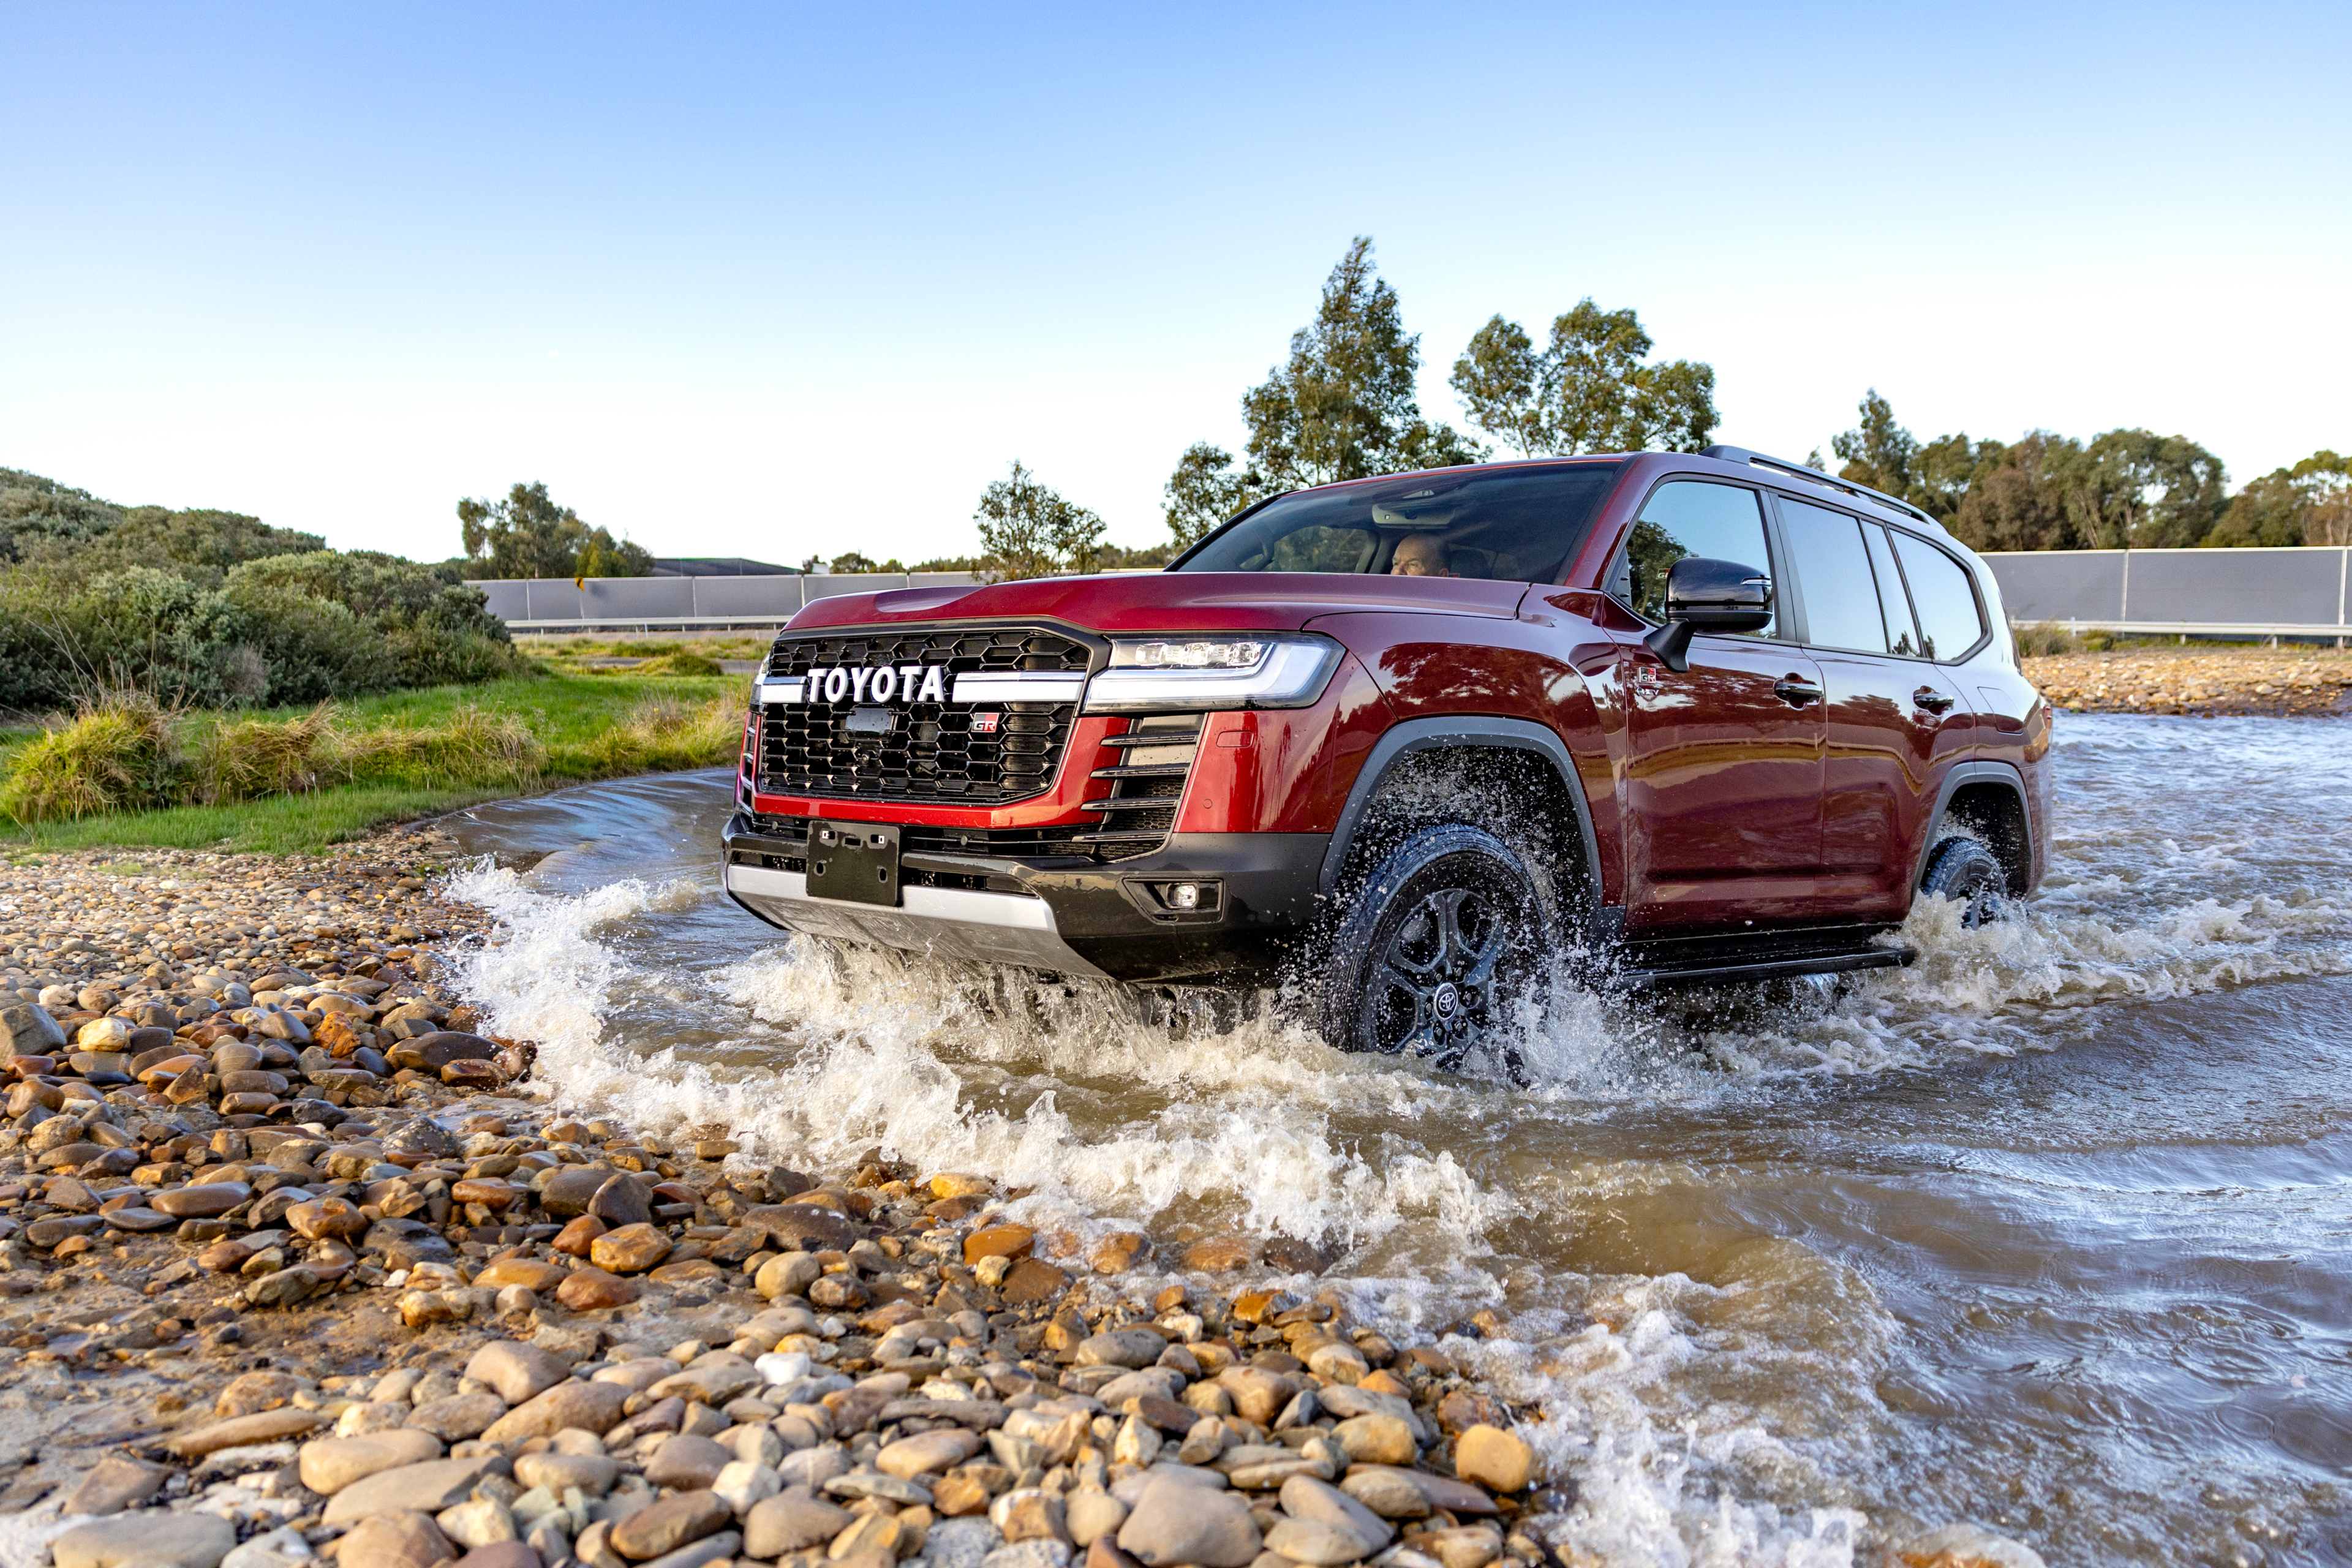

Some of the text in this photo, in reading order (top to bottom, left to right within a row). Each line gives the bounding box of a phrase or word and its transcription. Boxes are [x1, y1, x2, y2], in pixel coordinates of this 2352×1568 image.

[1641, 674, 1655, 682] GR
[807, 665, 944, 704] TOYOTA
[973, 720, 996, 731] GR
